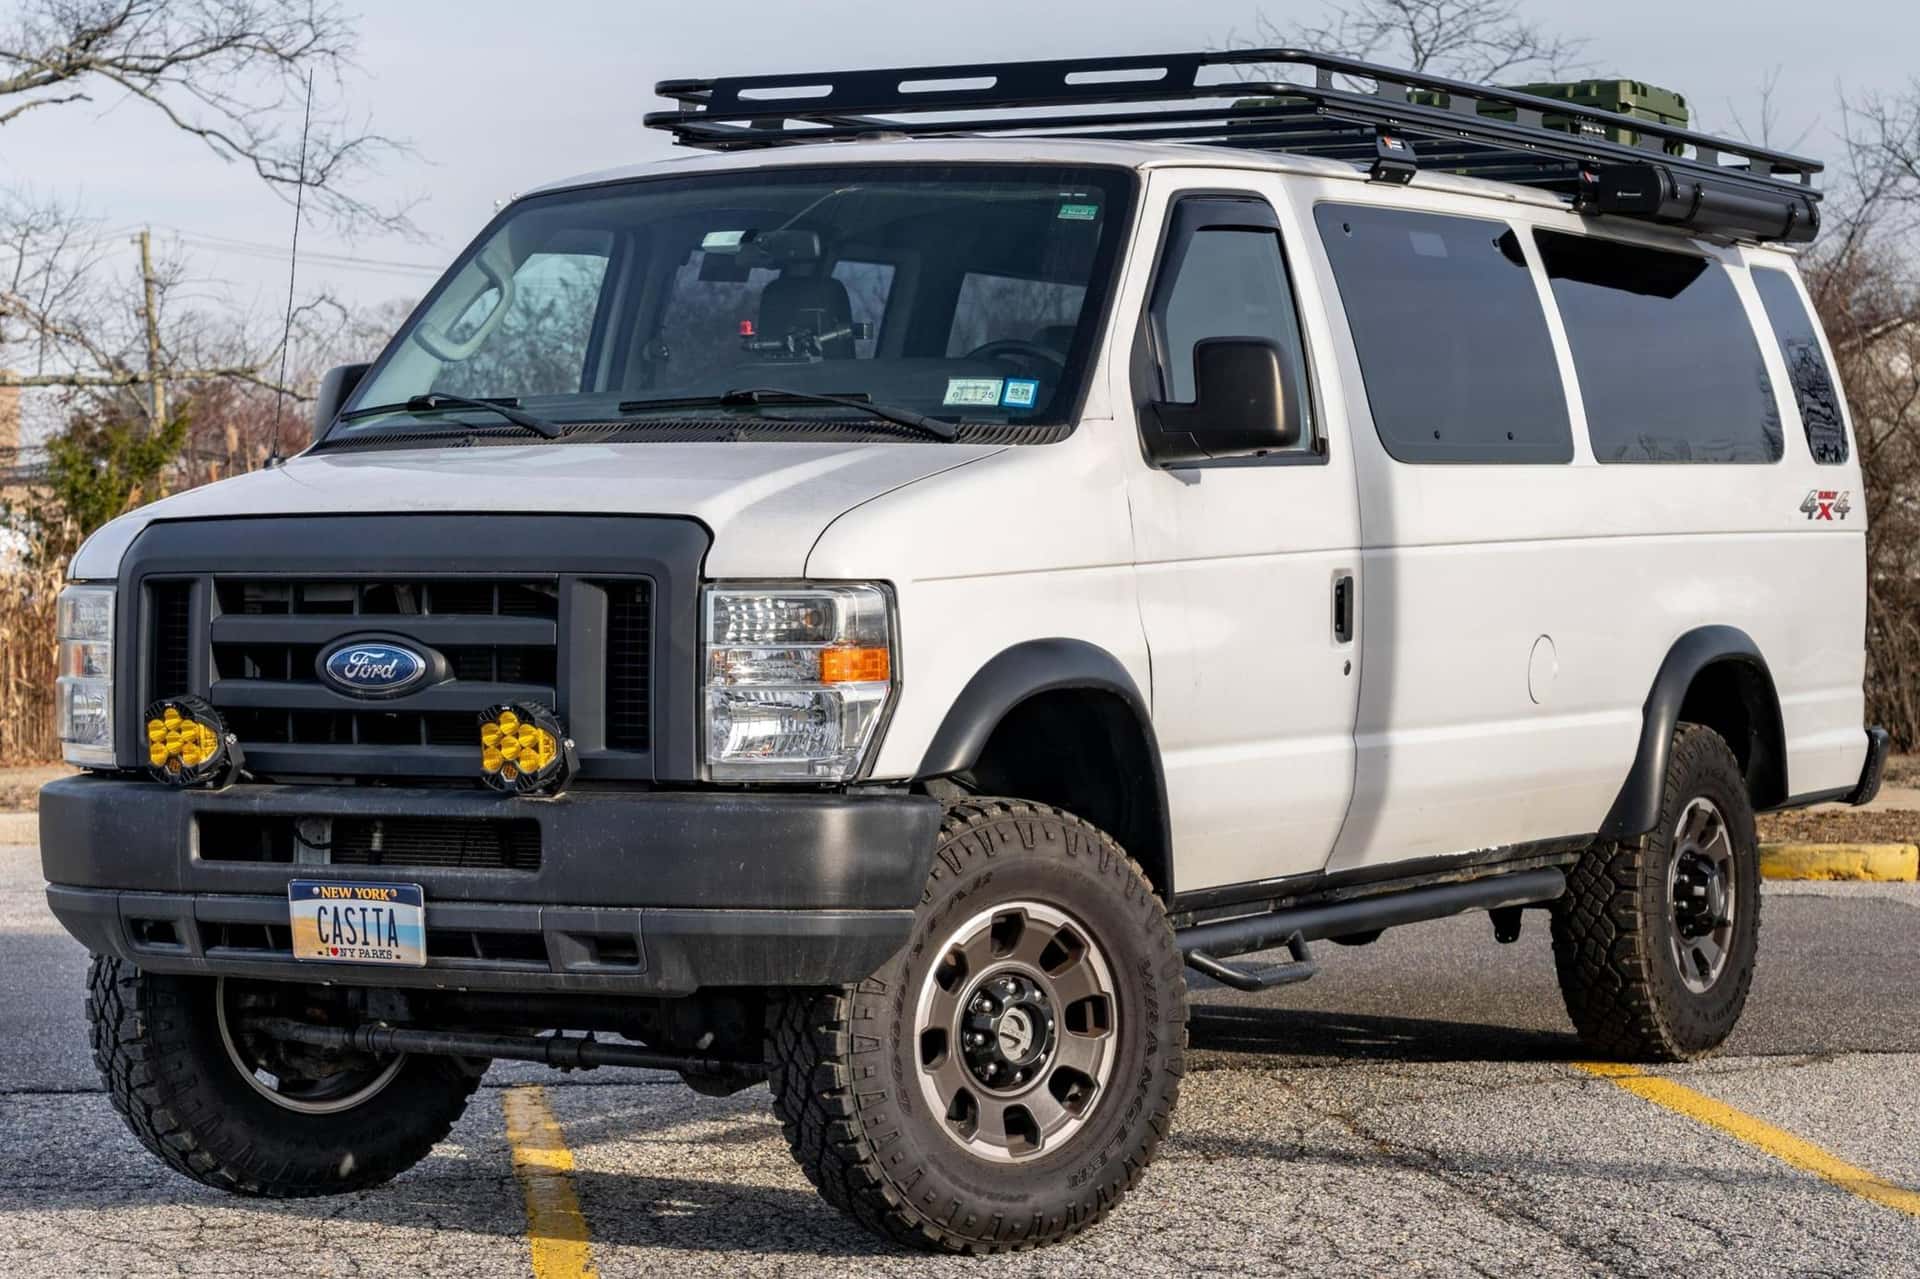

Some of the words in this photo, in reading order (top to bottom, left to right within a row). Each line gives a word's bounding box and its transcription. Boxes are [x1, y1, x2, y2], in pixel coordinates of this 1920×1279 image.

[344, 651, 398, 679] Ford
[321, 886, 352, 899] NEW
[354, 887, 391, 901] YORK
[317, 905, 399, 947] CASITA
[339, 948, 357, 958] NY
[358, 949, 393, 960] PARKS
